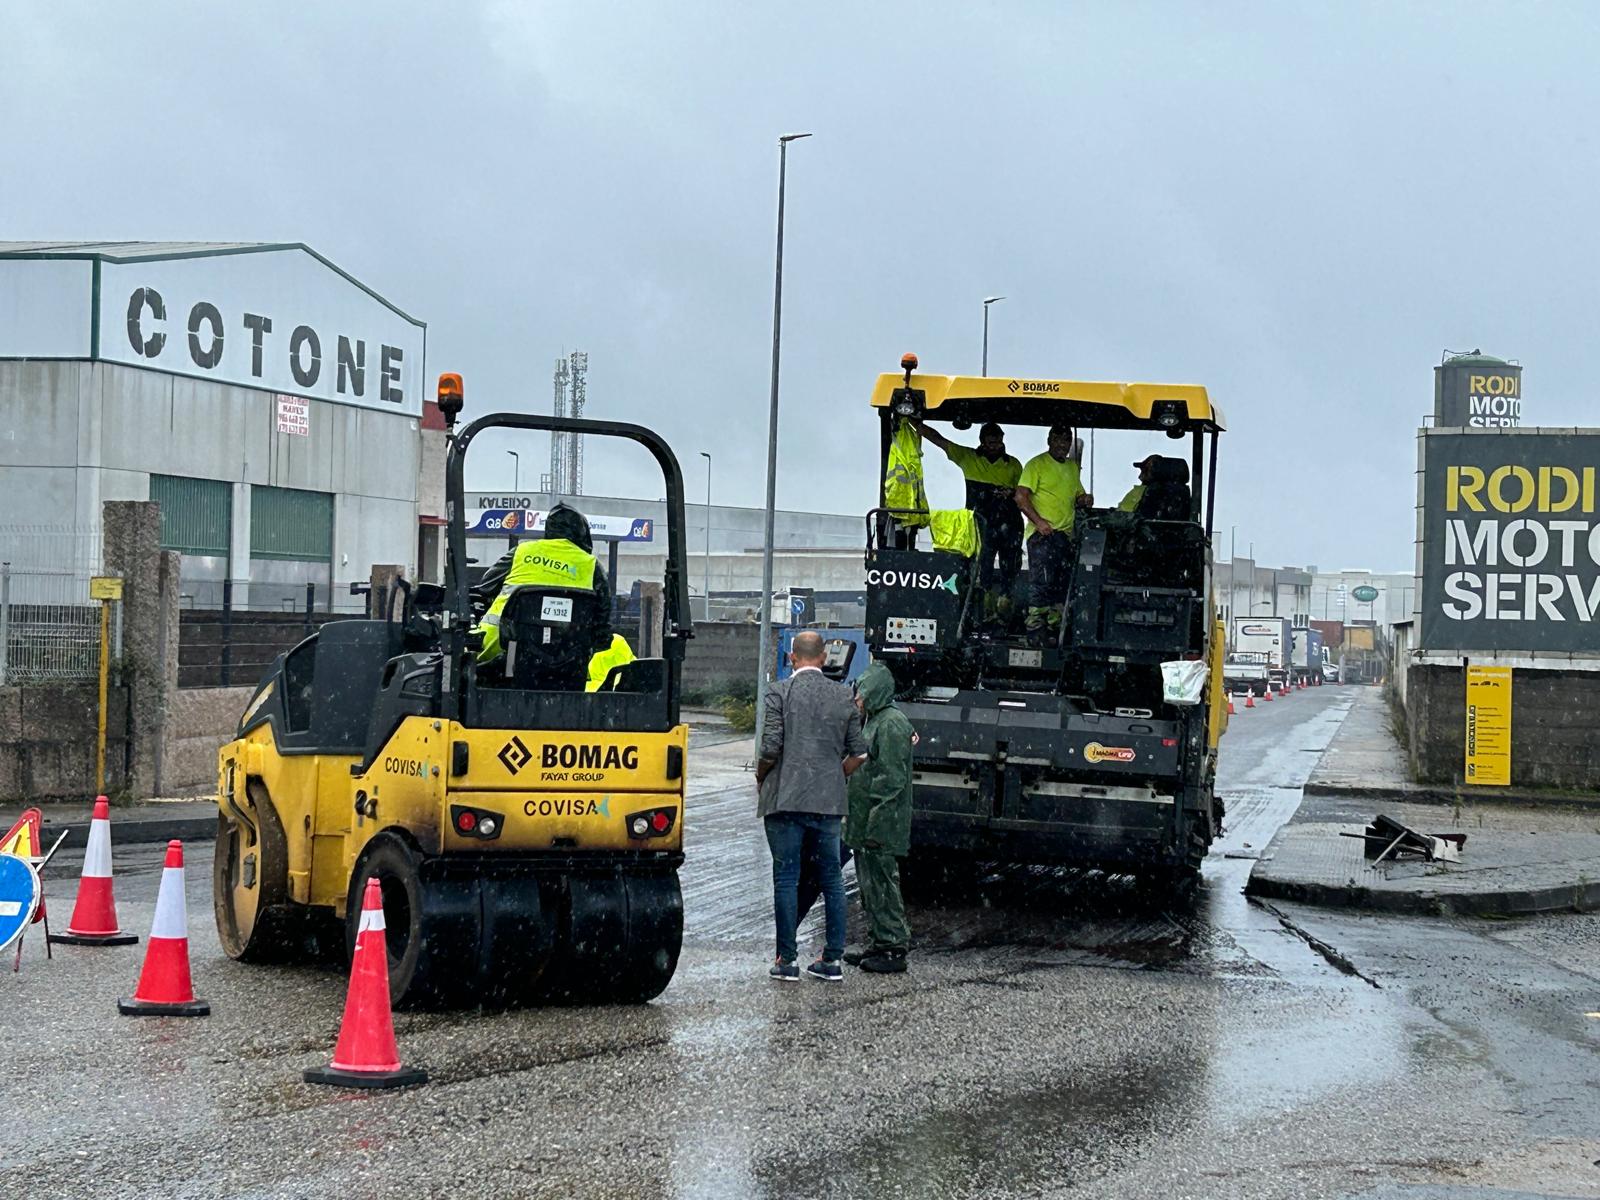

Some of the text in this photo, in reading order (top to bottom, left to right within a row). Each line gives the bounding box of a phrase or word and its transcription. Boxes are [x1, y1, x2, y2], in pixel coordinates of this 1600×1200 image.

[126, 286, 404, 404] COTONE
[1023, 382, 1060, 392] BOMAG
[1470, 375, 1518, 395] RODI
[1446, 465, 1596, 513] RODI
[485, 518, 502, 529] Q8
[1444, 518, 1600, 568] MOT
[523, 555, 570, 573] COVISA
[867, 569, 946, 591] COVISA
[385, 756, 424, 778] COVISA
[541, 744, 639, 770] BOMAG
[540, 772, 605, 782] FAYAT GROUP
[523, 799, 599, 817] COVISA
